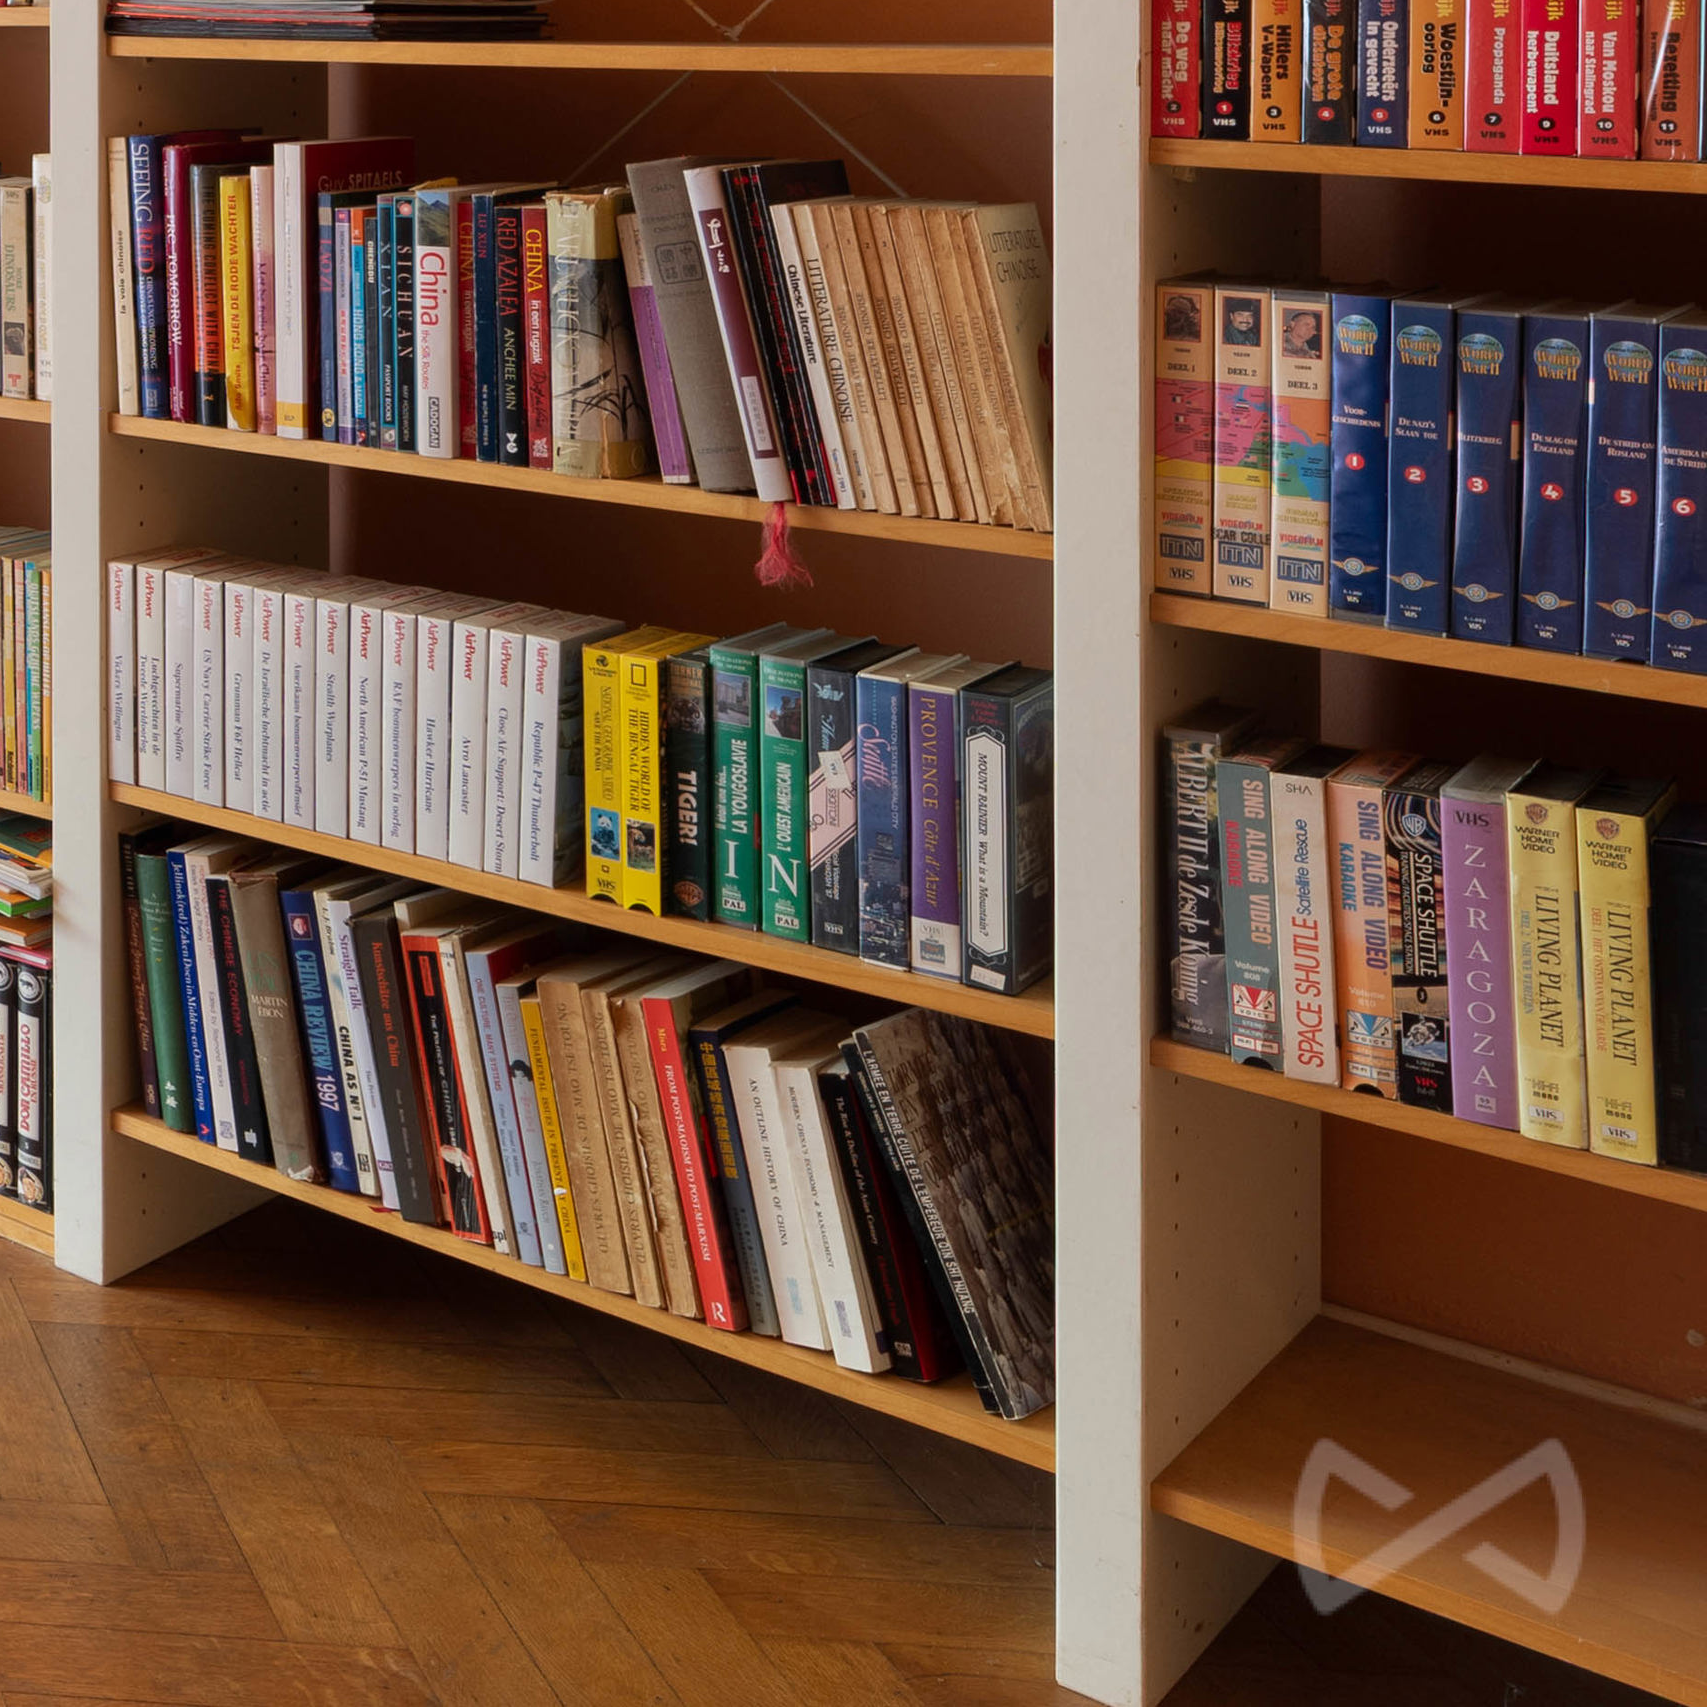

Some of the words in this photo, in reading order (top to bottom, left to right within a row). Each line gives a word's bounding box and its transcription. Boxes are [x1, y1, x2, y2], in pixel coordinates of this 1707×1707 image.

[1423, 23, 1436, 74] oorlog
[1438, 23, 1456, 108] Woestijn-
[1493, 27, 1506, 106] Propaganda
[1527, 30, 1540, 114] herbewapent
[1543, 31, 1560, 106] Duitsland
[131, 143, 153, 222] SEEING
[137, 227, 156, 274] RED
[497, 216, 516, 250] RED
[397, 244, 413, 358] SICHUAN
[419, 251, 447, 328] China
[498, 253, 517, 317] AZALEA
[786, 263, 803, 310] Chinese
[795, 310, 818, 365] Literature
[503, 327, 516, 383] ANCHEE
[807, 257, 839, 355] LITTERATURE
[828, 357, 854, 424] CHINOISE
[1606, 353, 1653, 370] WORLD
[505, 384, 516, 410] MIN
[1608, 366, 1636, 383] WAR
[1638, 368, 1649, 384] II
[429, 396, 440, 449] CADOGAN
[1161, 536, 1202, 559] ITN
[1219, 543, 1262, 568] ITN
[1279, 558, 1323, 583] ITN
[145, 571, 156, 619] AirPower
[1229, 576, 1253, 588] VHS
[360, 609, 372, 660] AirPower
[426, 619, 440, 671] AirPower
[465, 629, 477, 681] AirPower
[425, 718, 437, 758] Hawker
[460, 736, 471, 758] Avro
[532, 720, 545, 767] Republic
[920, 696, 939, 810] PROVENCE
[425, 760, 436, 814] Hurricane
[459, 761, 470, 815] Lancaster
[732, 739, 747, 816] YOUGOSLAVIE
[776, 762, 792, 811] AMERICAIN
[977, 753, 989, 789] MOUNT
[677, 769, 697, 847] TIGER!
[977, 791, 989, 836] RAINIER
[1242, 778, 1265, 820] SING
[1455, 809, 1490, 828] VHS
[530, 796, 542, 863] Thunderbolt
[732, 817, 747, 834] LA
[925, 818, 940, 846] Côte
[1293, 818, 1309, 863] Rescue
[1515, 825, 1559, 839] WARNER
[1520, 834, 1555, 847] HOME
[1520, 842, 1556, 855] VIDEO
[724, 840, 741, 879] I
[767, 854, 802, 898] N
[926, 847, 940, 907] d'Azur
[1245, 827, 1268, 885] ALONG
[1338, 841, 1357, 912] KARAOKE
[723, 897, 745, 911] PAL
[1292, 865, 1312, 916] Satellite
[776, 915, 799, 929] PAL
[1249, 894, 1272, 945] VIDEO
[1535, 894, 1562, 965] LIVING
[294, 949, 318, 1003] CHINA
[1291, 916, 1322, 996] SHUTTLE
[1463, 844, 1498, 1089] ZARAGOZA
[251, 994, 290, 1009] MARTIN
[258, 1006, 285, 1019] EBON
[1537, 969, 1565, 1048] PLANET
[19, 1024, 32, 1094] CAMILLO
[303, 1004, 334, 1072] REVIEW
[1297, 1001, 1324, 1068] SPACE
[19, 1097, 32, 1133] DON
[315, 1075, 341, 1112] 1997
[883, 1102, 904, 1138] TERRE
[897, 1136, 916, 1169] CUITE
[910, 1167, 923, 1184] DE
[953, 1277, 976, 1315] HUANG
